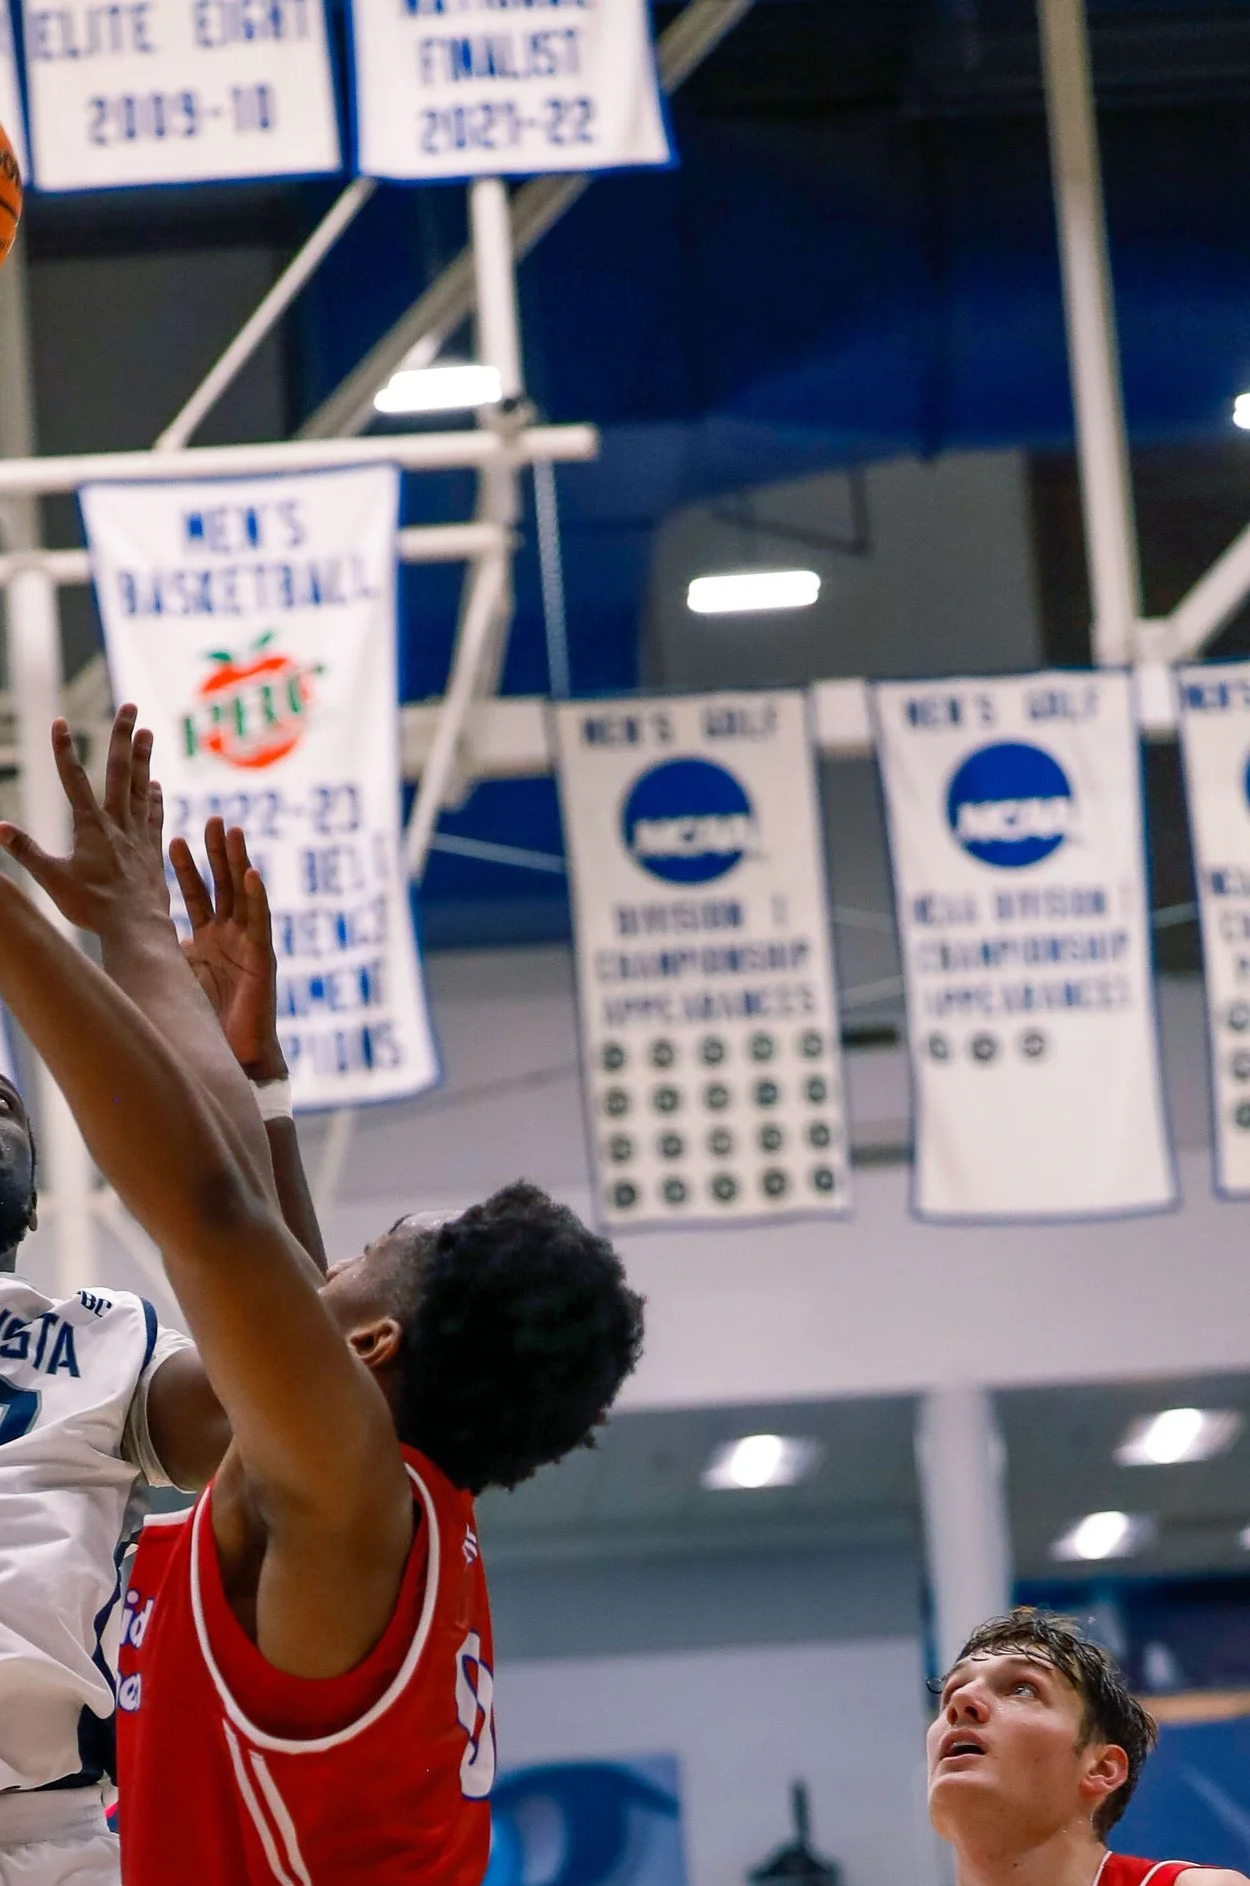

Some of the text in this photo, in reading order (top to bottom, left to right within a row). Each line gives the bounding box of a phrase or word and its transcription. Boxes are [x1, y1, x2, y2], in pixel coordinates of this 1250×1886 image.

[417, 28, 581, 88] FINALIST
[420, 97, 600, 156] 2021-22
[182, 499, 307, 557] MEN'S
[117, 552, 381, 618] BASKETBALL
[582, 704, 778, 748] MEN'S GOLF
[904, 689, 1098, 731] MEN'S GOLF
[171, 781, 361, 841] 222-23
[617, 898, 744, 937] DIVISION
[595, 939, 810, 984] CHAMPIONSHIP
[917, 932, 1129, 976] CHAMPIONSHIP
